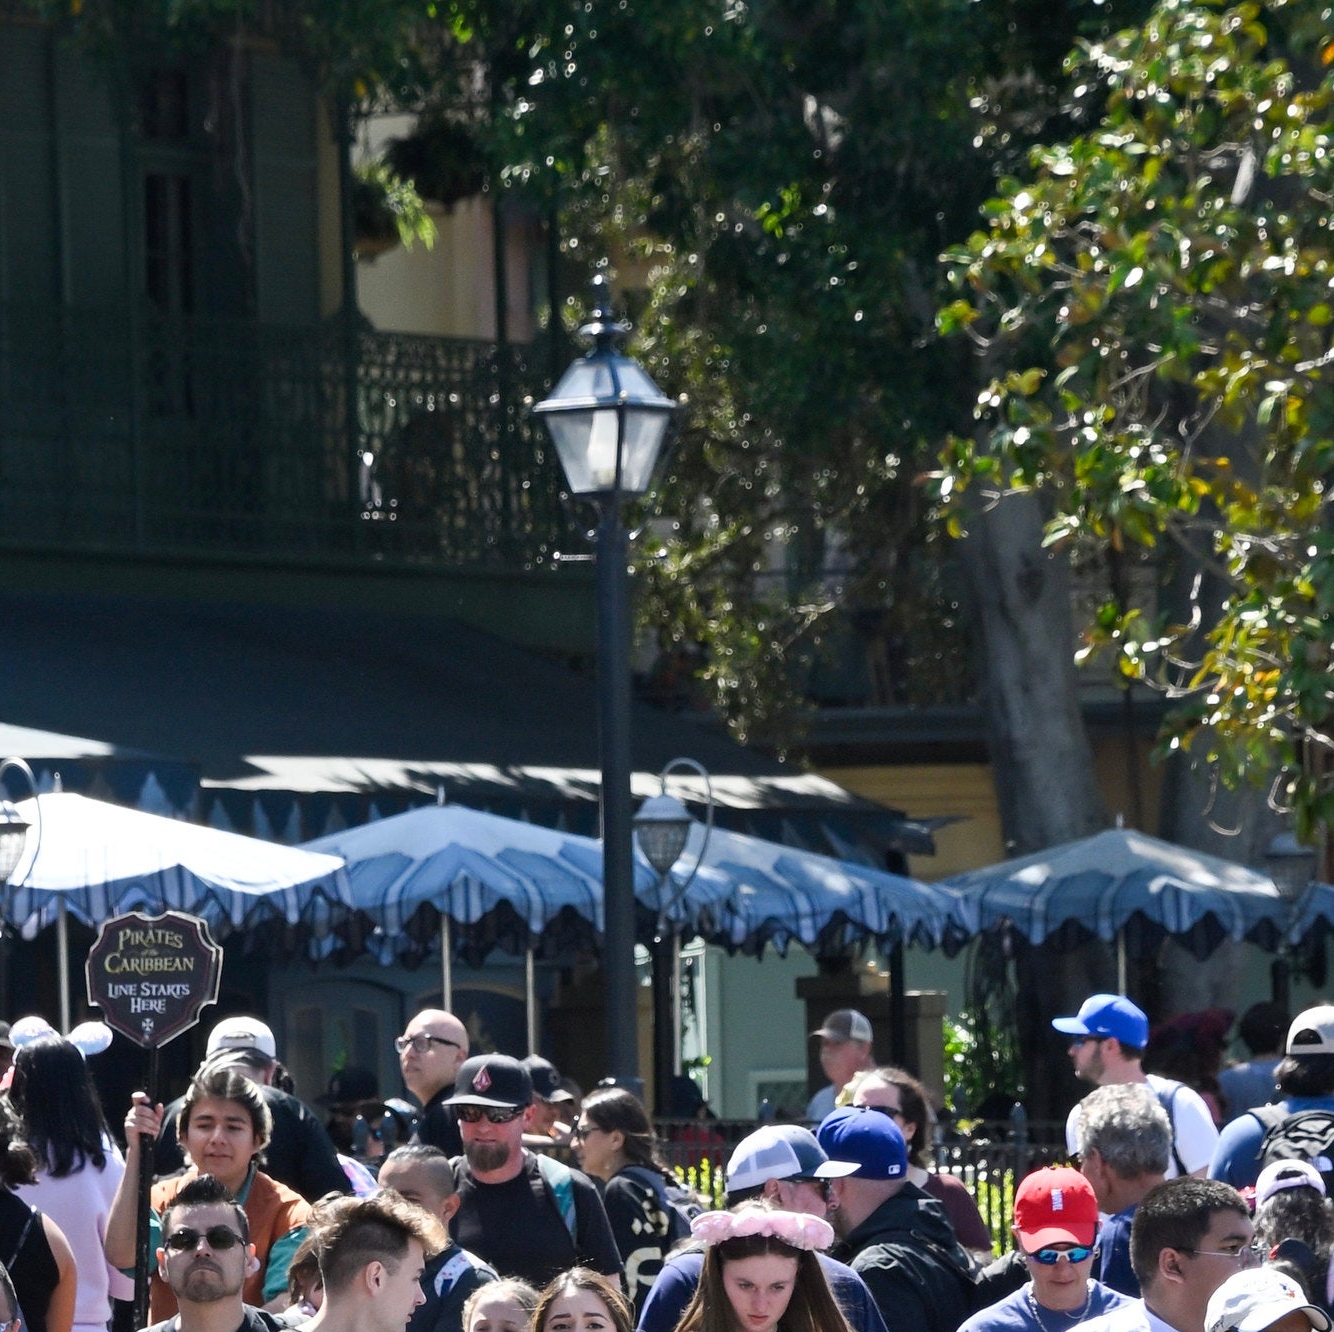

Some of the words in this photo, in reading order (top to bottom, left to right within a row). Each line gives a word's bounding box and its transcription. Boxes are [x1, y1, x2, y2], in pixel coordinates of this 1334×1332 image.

[118, 928, 184, 951] PIRATES
[104, 952, 195, 976] CARIBBEAN
[108, 983, 137, 999] LINE
[140, 982, 190, 999] STARTS
[130, 997, 167, 1014] HERE
